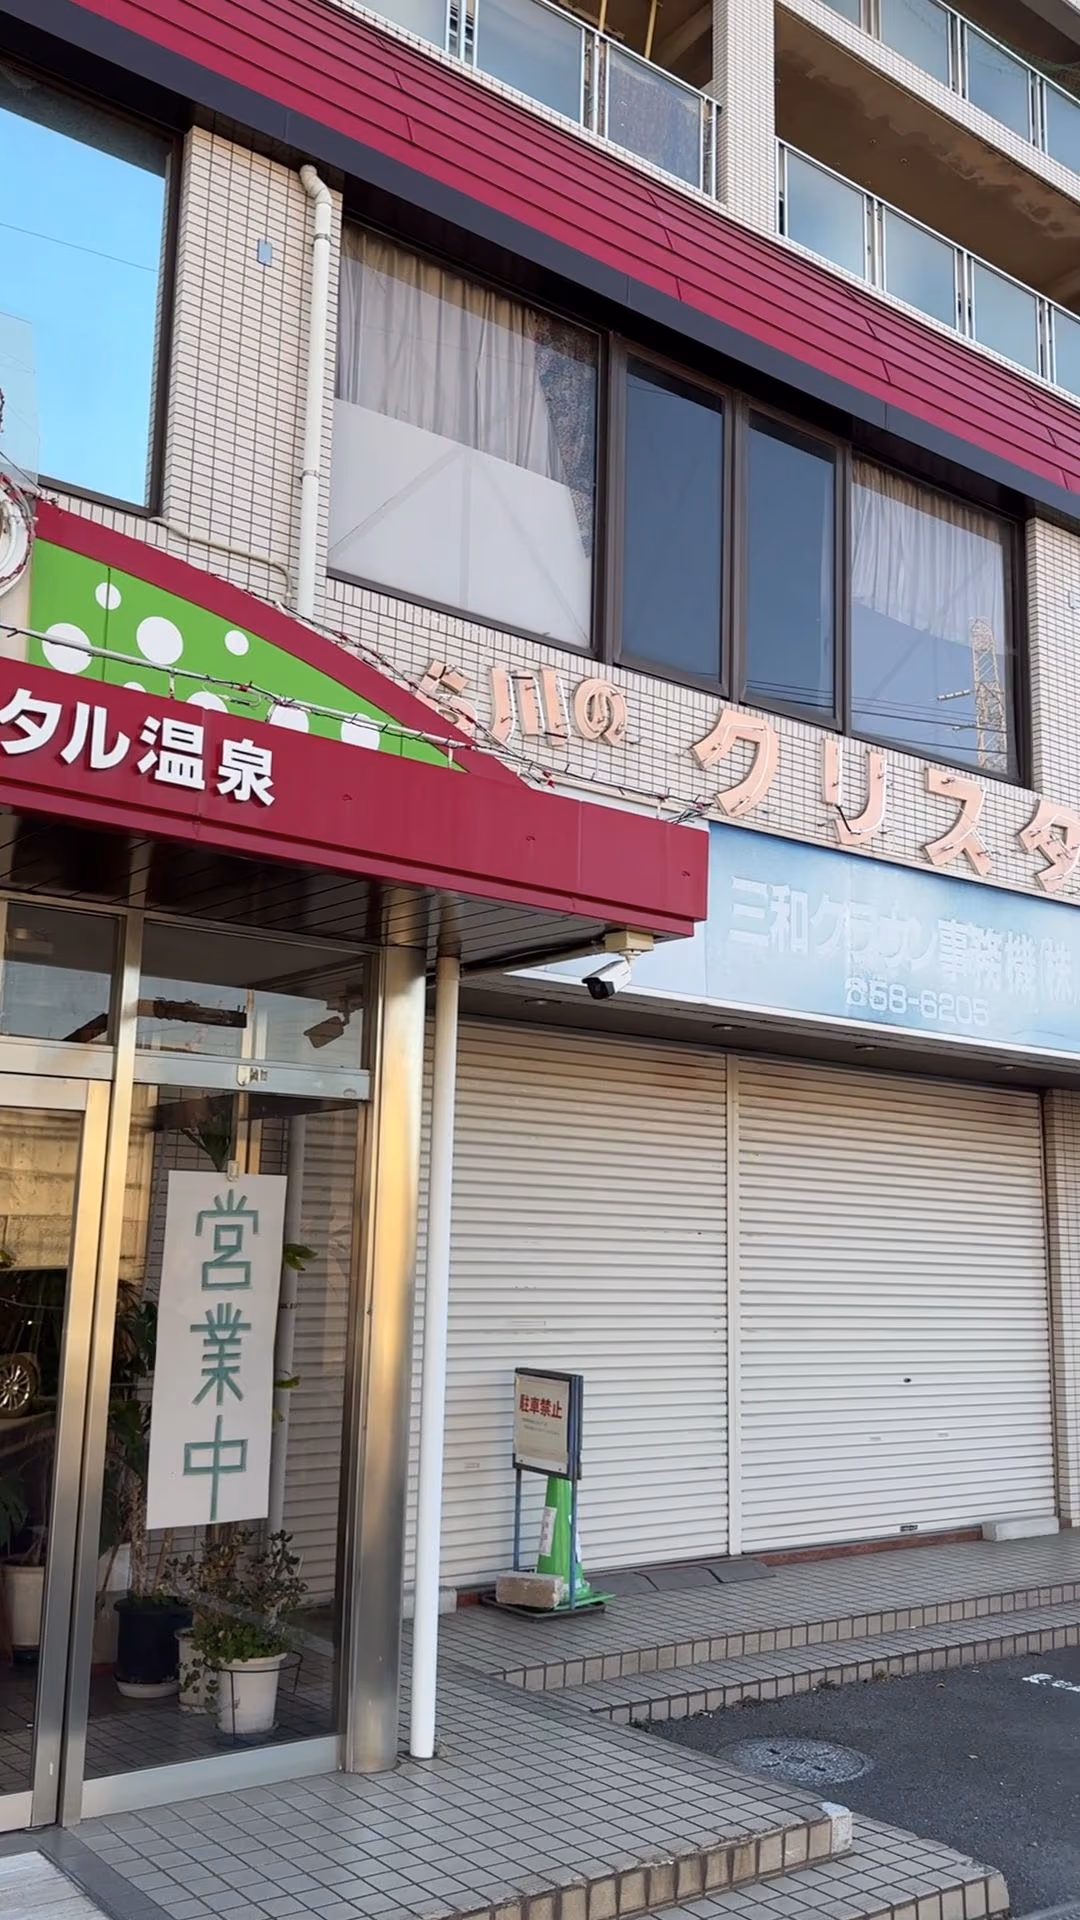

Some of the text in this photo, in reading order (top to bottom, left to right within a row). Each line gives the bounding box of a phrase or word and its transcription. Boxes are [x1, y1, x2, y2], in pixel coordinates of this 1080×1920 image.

[0, 687, 275, 807] タル温泉
[183, 1188, 260, 1522] 営業中
[519, 1393, 563, 1419] 駐車禁止
